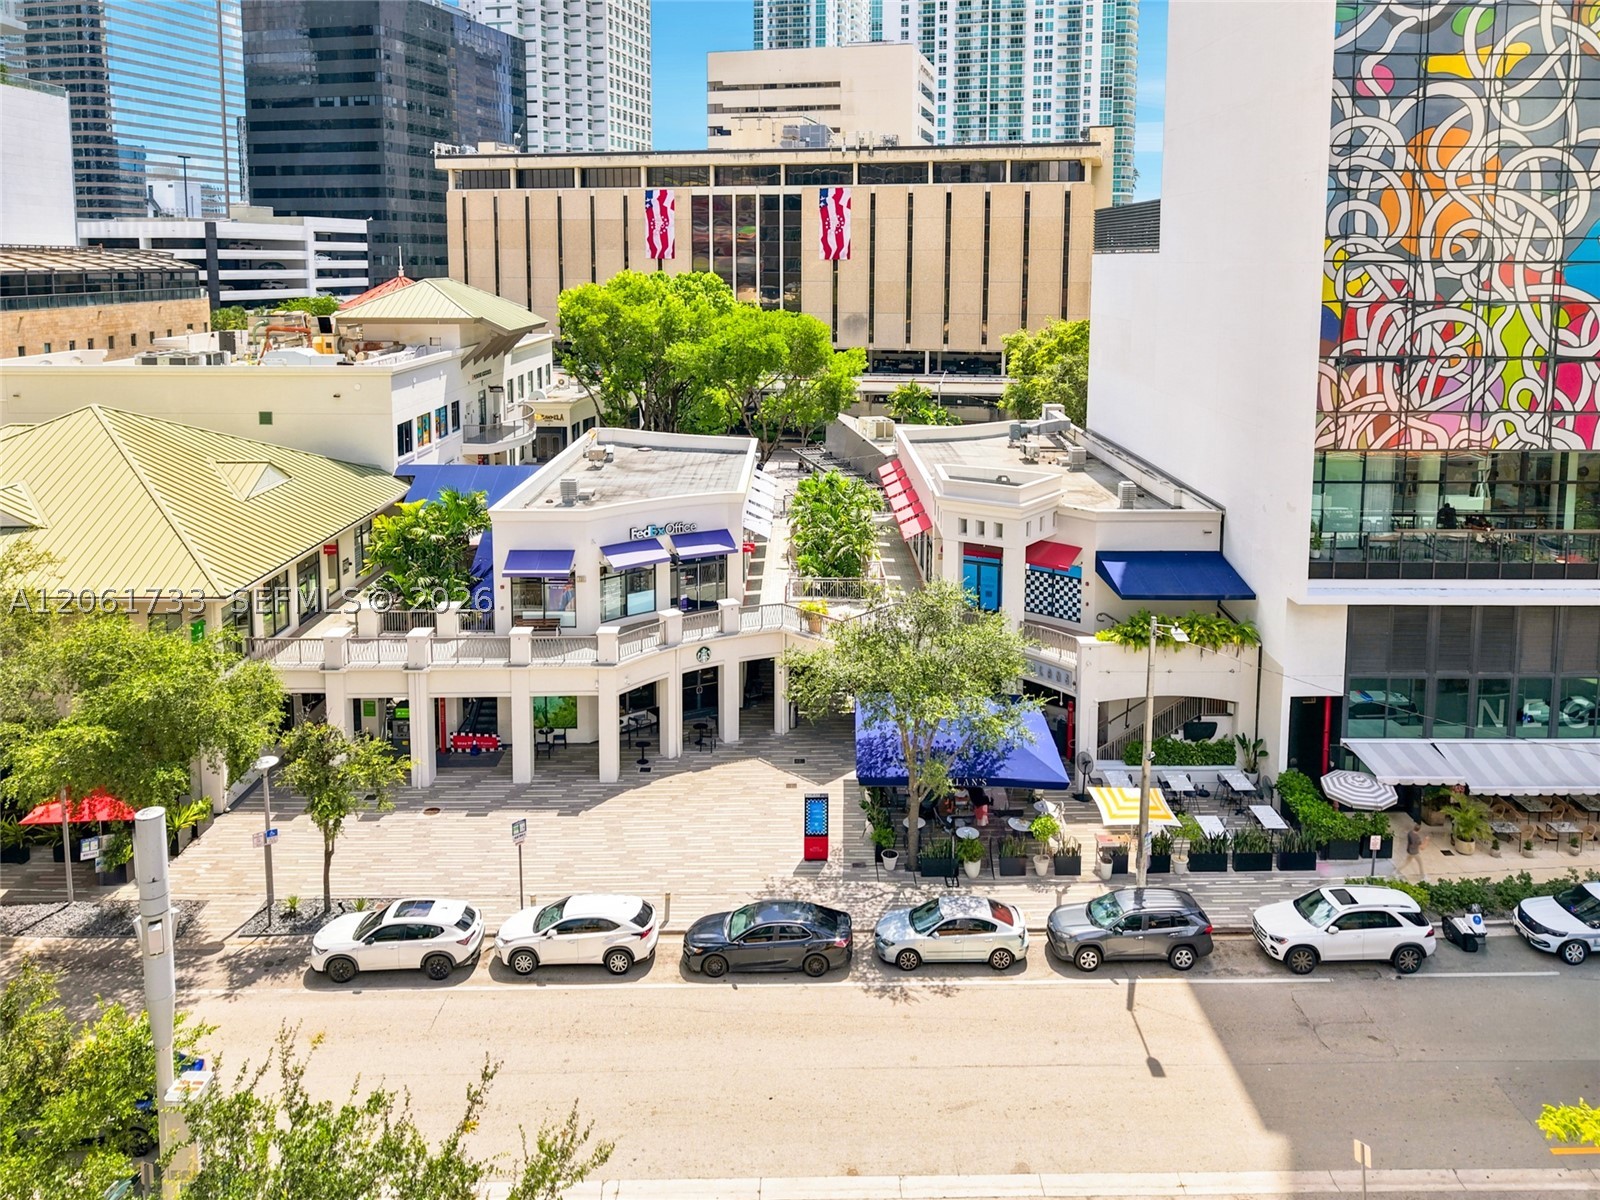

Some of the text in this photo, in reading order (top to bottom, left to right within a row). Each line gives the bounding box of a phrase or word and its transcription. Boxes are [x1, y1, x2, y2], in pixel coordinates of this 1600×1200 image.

[630, 521, 697, 540] FedEx Office
[951, 778, 987, 786] LAN'S
